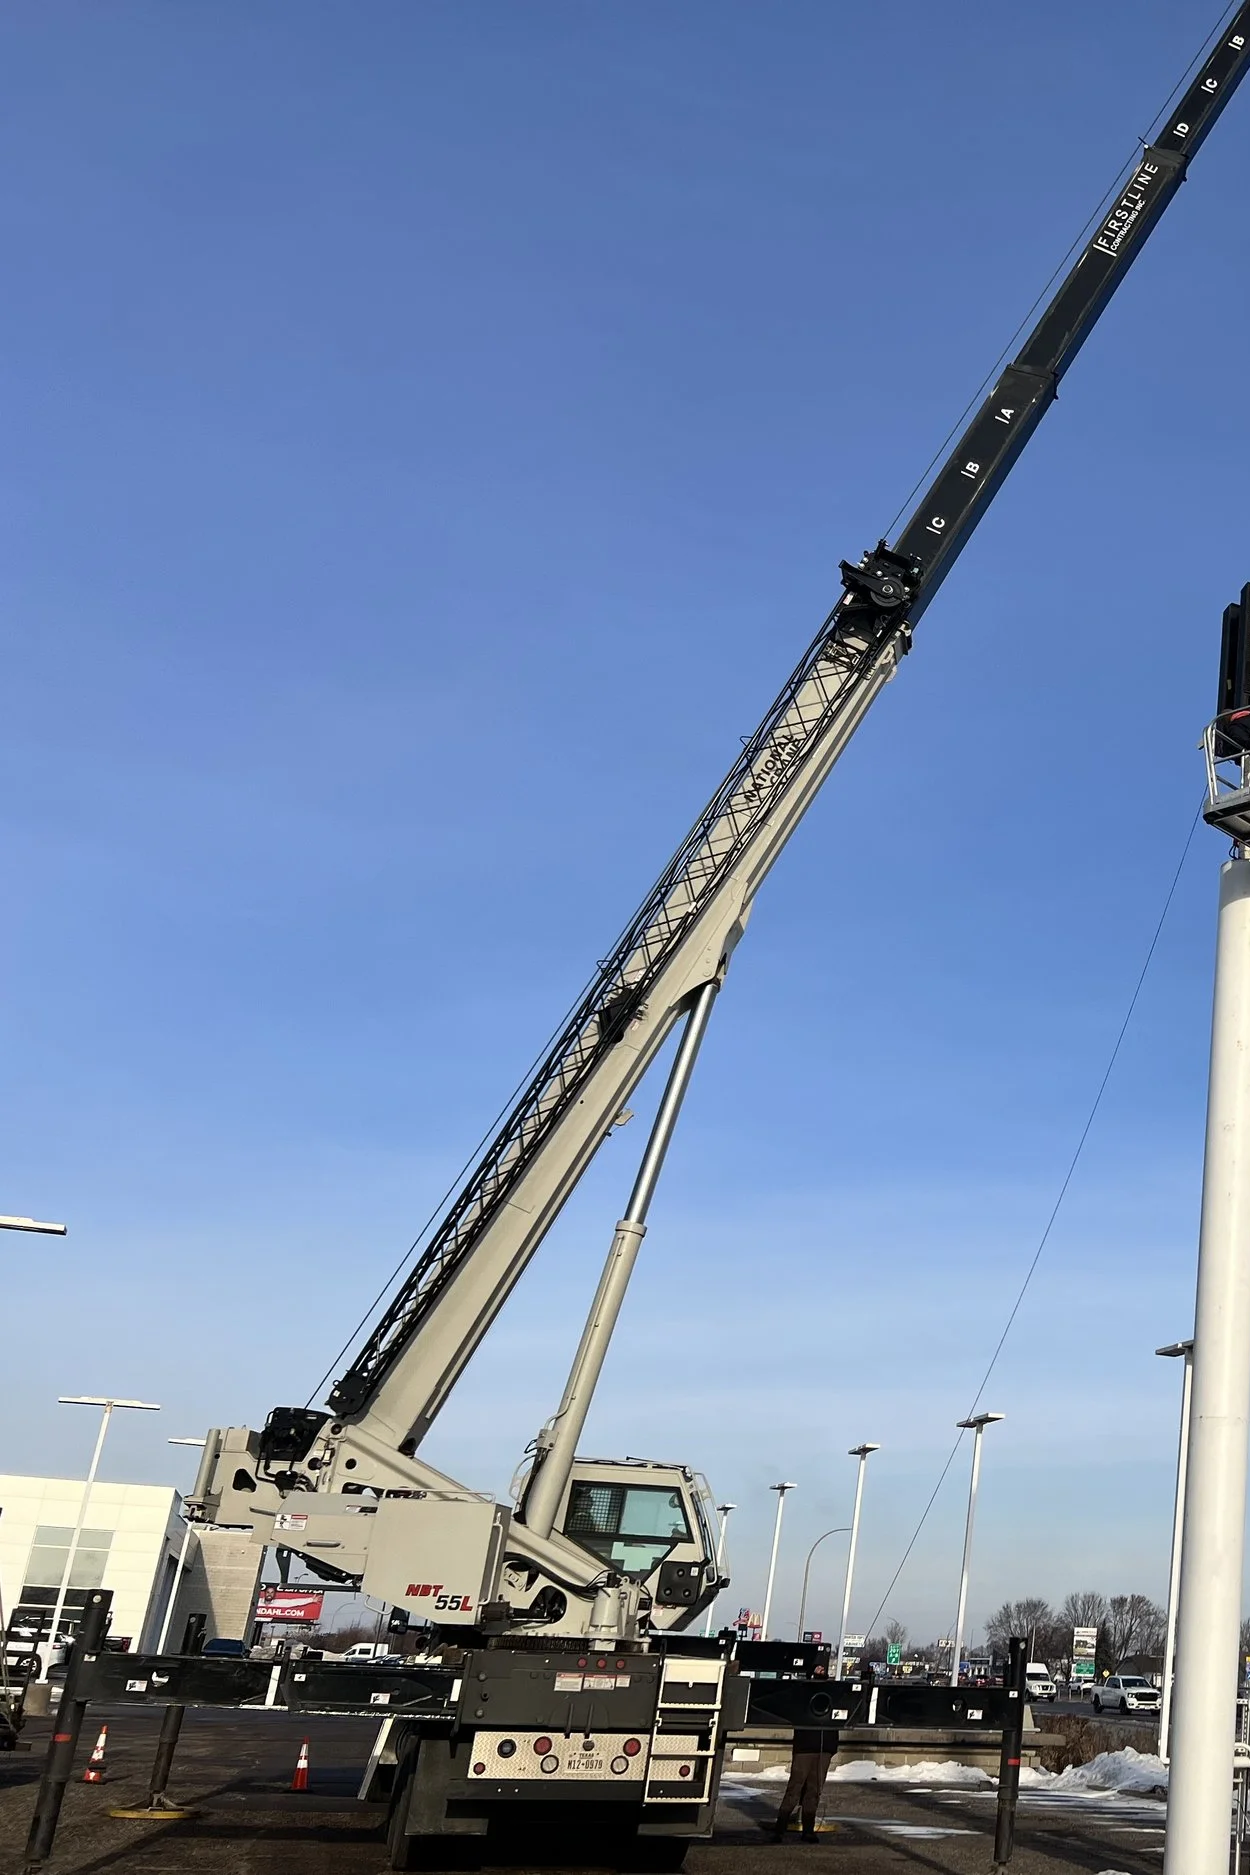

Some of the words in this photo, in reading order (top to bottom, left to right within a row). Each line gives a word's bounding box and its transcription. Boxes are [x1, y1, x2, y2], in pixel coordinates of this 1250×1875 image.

[1098, 162, 1159, 248] FIRSTLINE
[1110, 209, 1139, 251] CONTRACTING
[1135, 199, 1147, 212] INC.
[744, 734, 794, 802] NATIONAL
[405, 1584, 443, 1597] NBT
[434, 1595, 473, 1611] 55L
[256, 1608, 305, 1617] NDAHL.COM
